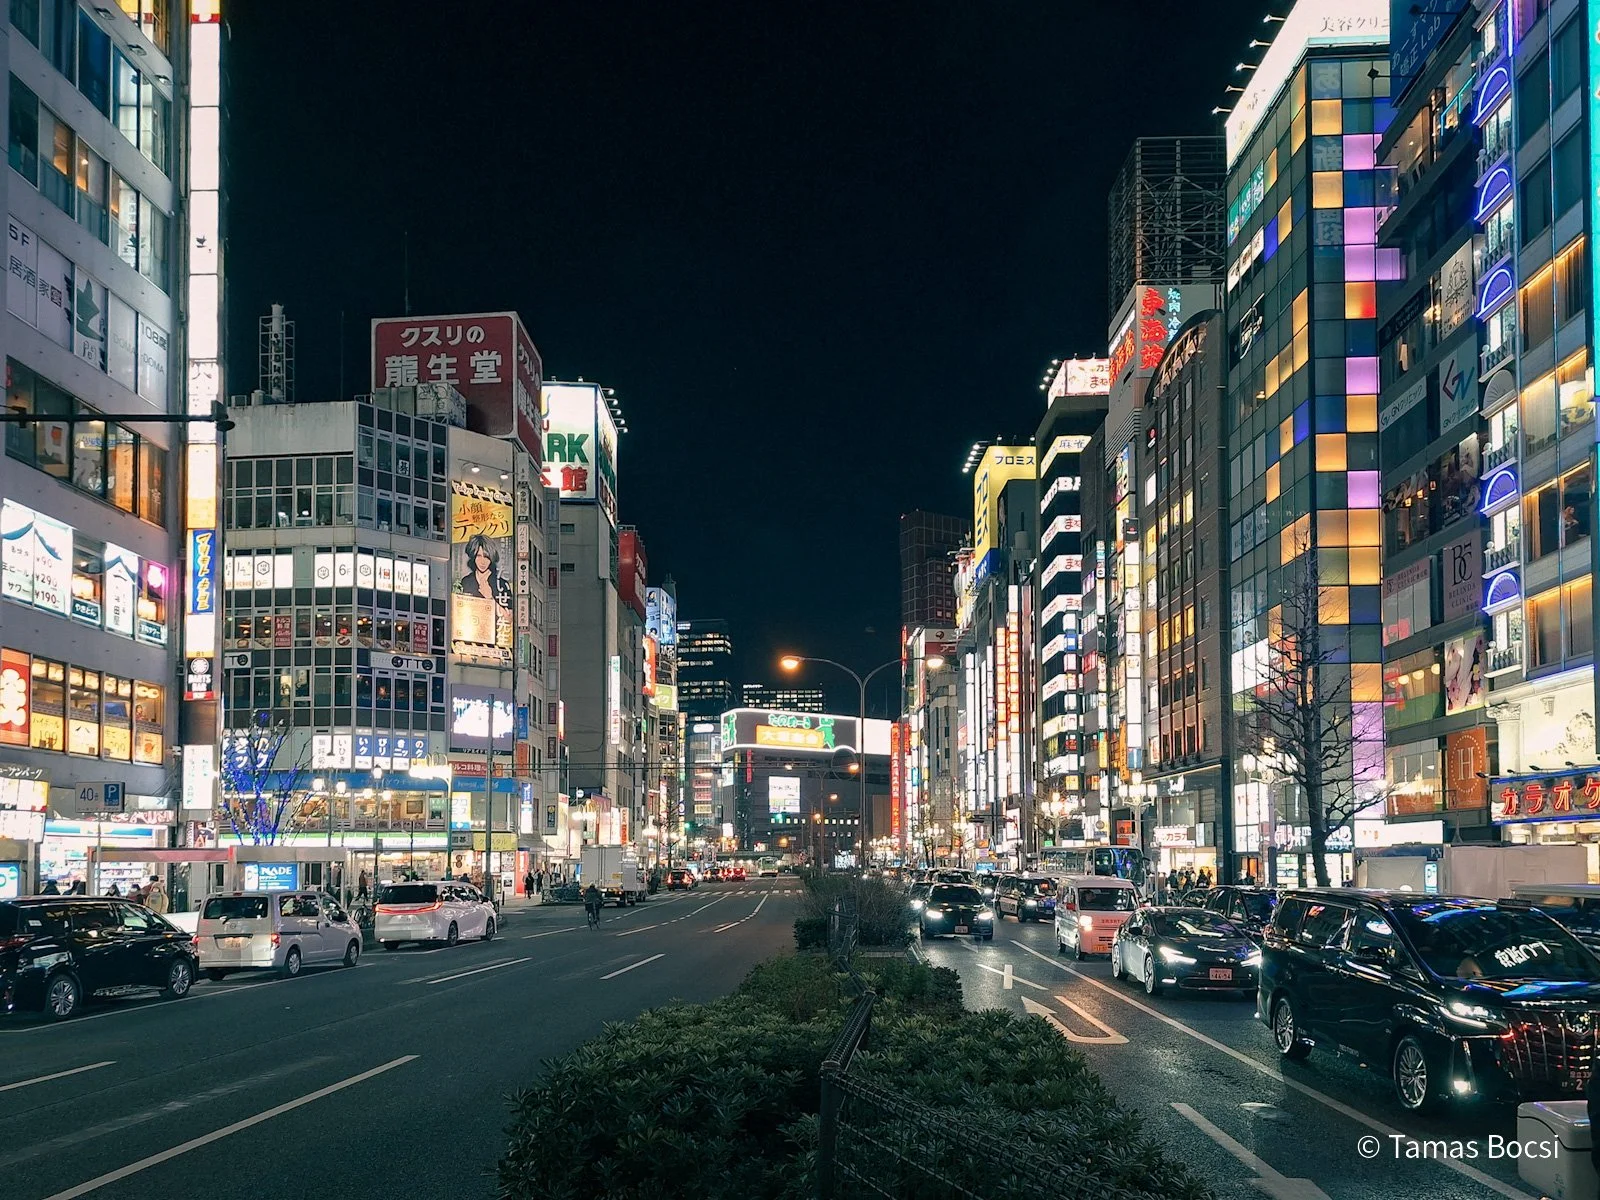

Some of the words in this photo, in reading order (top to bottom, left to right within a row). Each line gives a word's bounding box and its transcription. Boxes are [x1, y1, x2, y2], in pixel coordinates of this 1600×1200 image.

[400, 325, 485, 348] クスリの
[384, 350, 502, 388] 龍生堂
[995, 456, 1035, 466] プロミス
[454, 520, 509, 540] テンクリ
[1452, 594, 1473, 608] CLINIC
[1457, 747, 1474, 780] H
[108, 785, 117, 798] P
[1501, 777, 1600, 815] カラオケ
